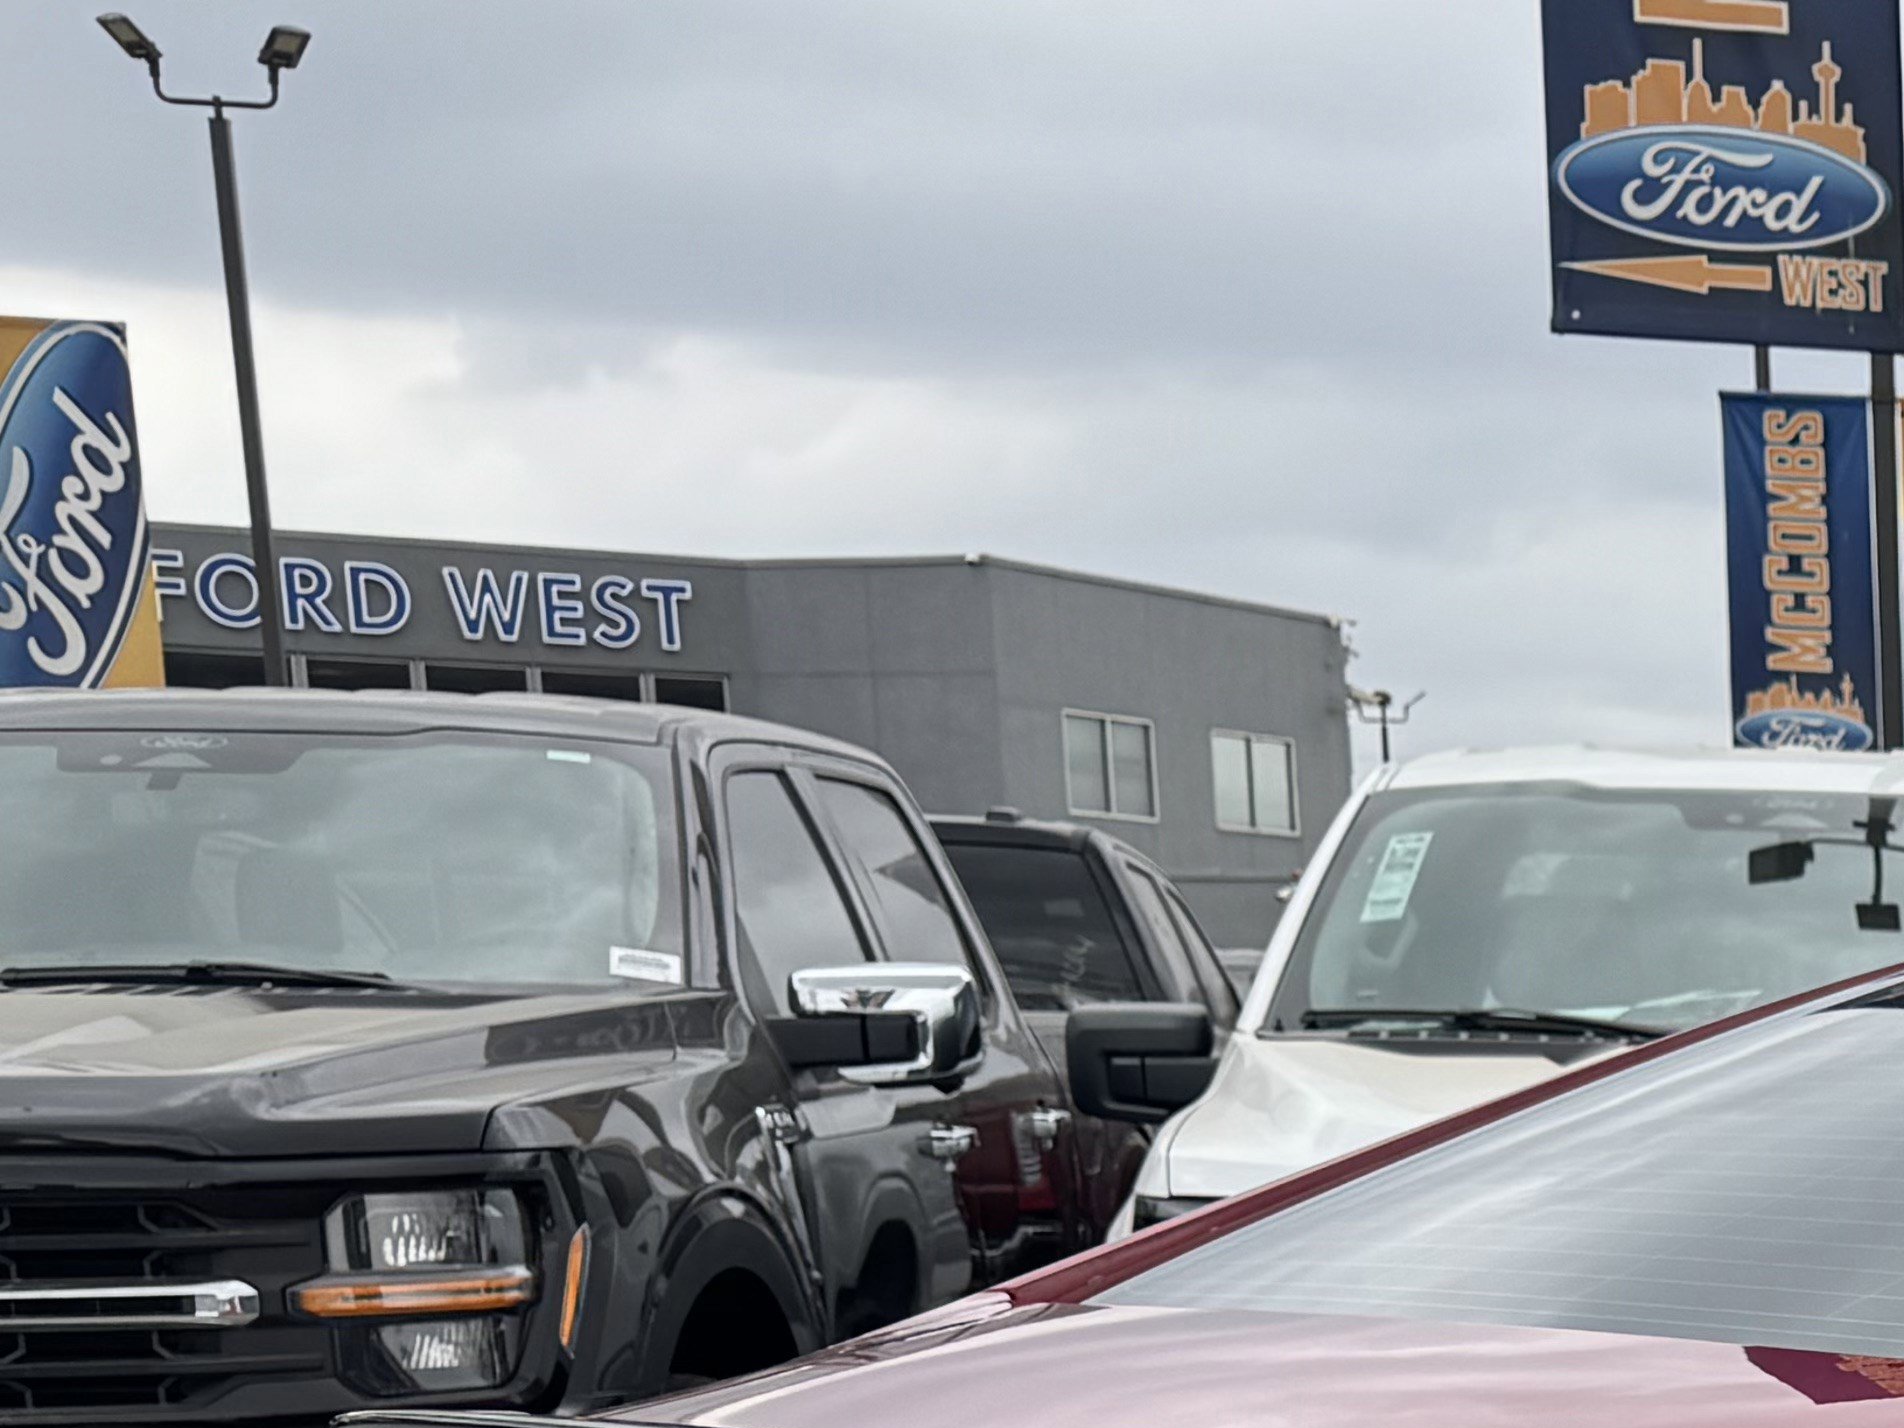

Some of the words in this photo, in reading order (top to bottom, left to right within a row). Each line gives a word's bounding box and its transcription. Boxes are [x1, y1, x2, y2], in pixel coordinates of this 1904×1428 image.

[1621, 140, 1826, 234] Ford
[1777, 254, 1889, 313] WEST
[0, 385, 132, 676] Ford
[150, 548, 412, 635] FORD
[442, 566, 693, 652] WEST
